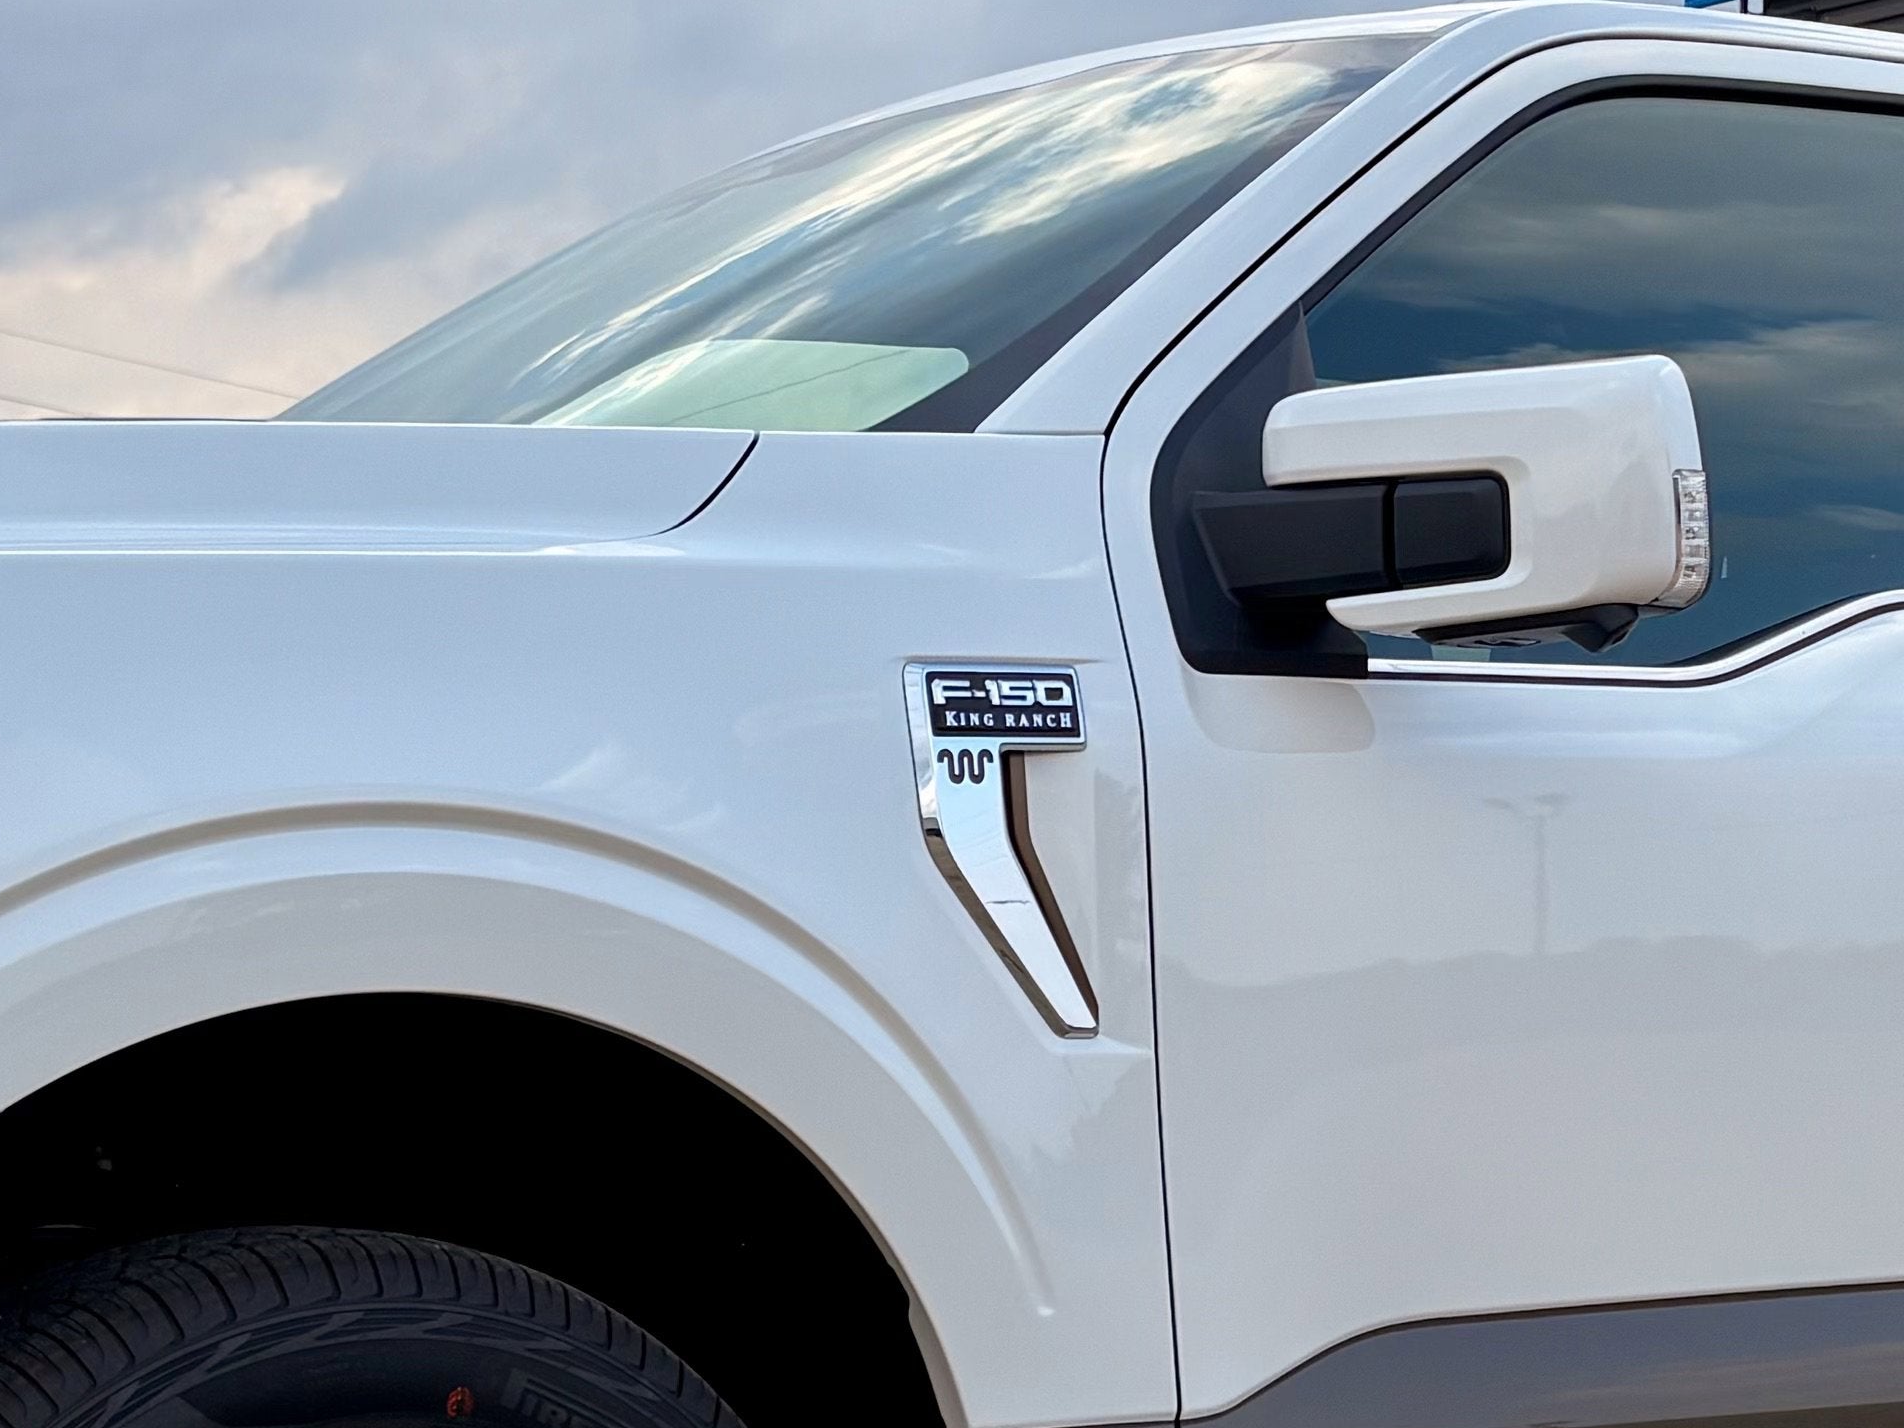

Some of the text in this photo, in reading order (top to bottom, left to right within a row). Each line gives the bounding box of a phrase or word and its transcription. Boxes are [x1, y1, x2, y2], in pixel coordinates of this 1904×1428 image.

[931, 678, 1073, 706] F-150
[945, 711, 1072, 728] KING RANCH
